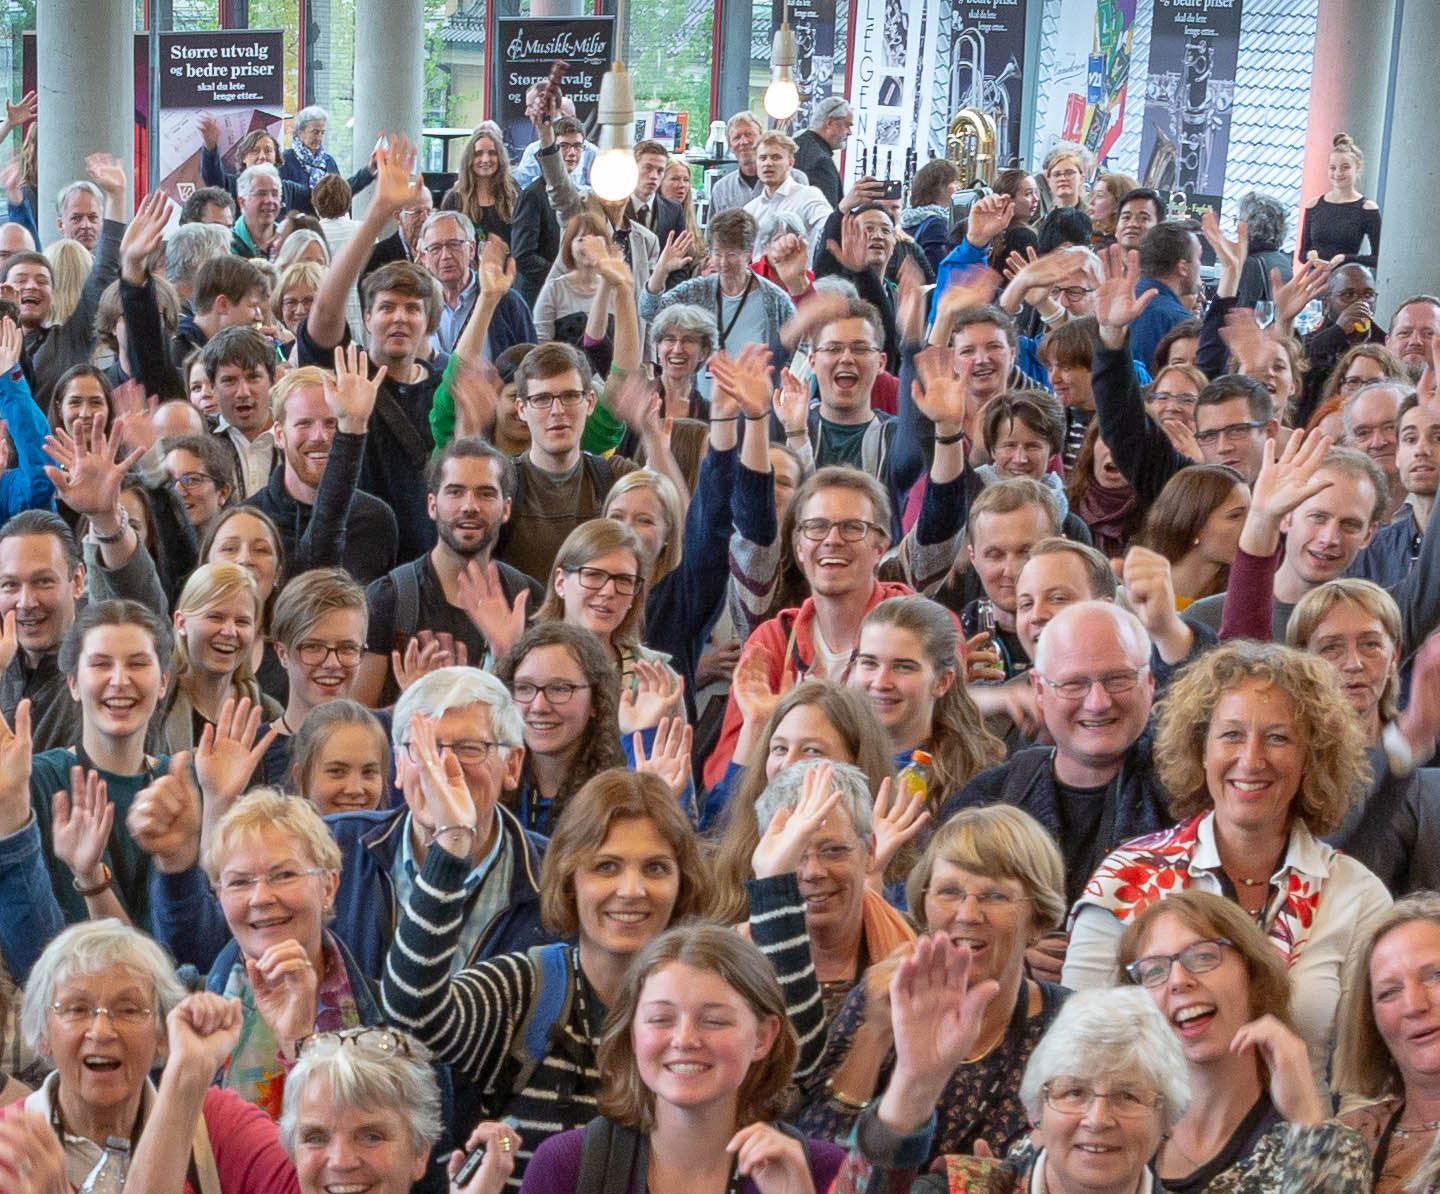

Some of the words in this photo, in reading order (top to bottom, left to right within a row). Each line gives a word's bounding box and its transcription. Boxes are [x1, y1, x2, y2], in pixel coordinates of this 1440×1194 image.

[170, 45, 218, 59] Større
[221, 43, 269, 60] utvalg
[522, 32, 607, 57] Musikk-Miljø
[170, 66, 183, 76] og
[186, 63, 228, 77] bedre
[230, 61, 275, 79] priser
[216, 82, 228, 91] du
[508, 92, 522, 103] og
